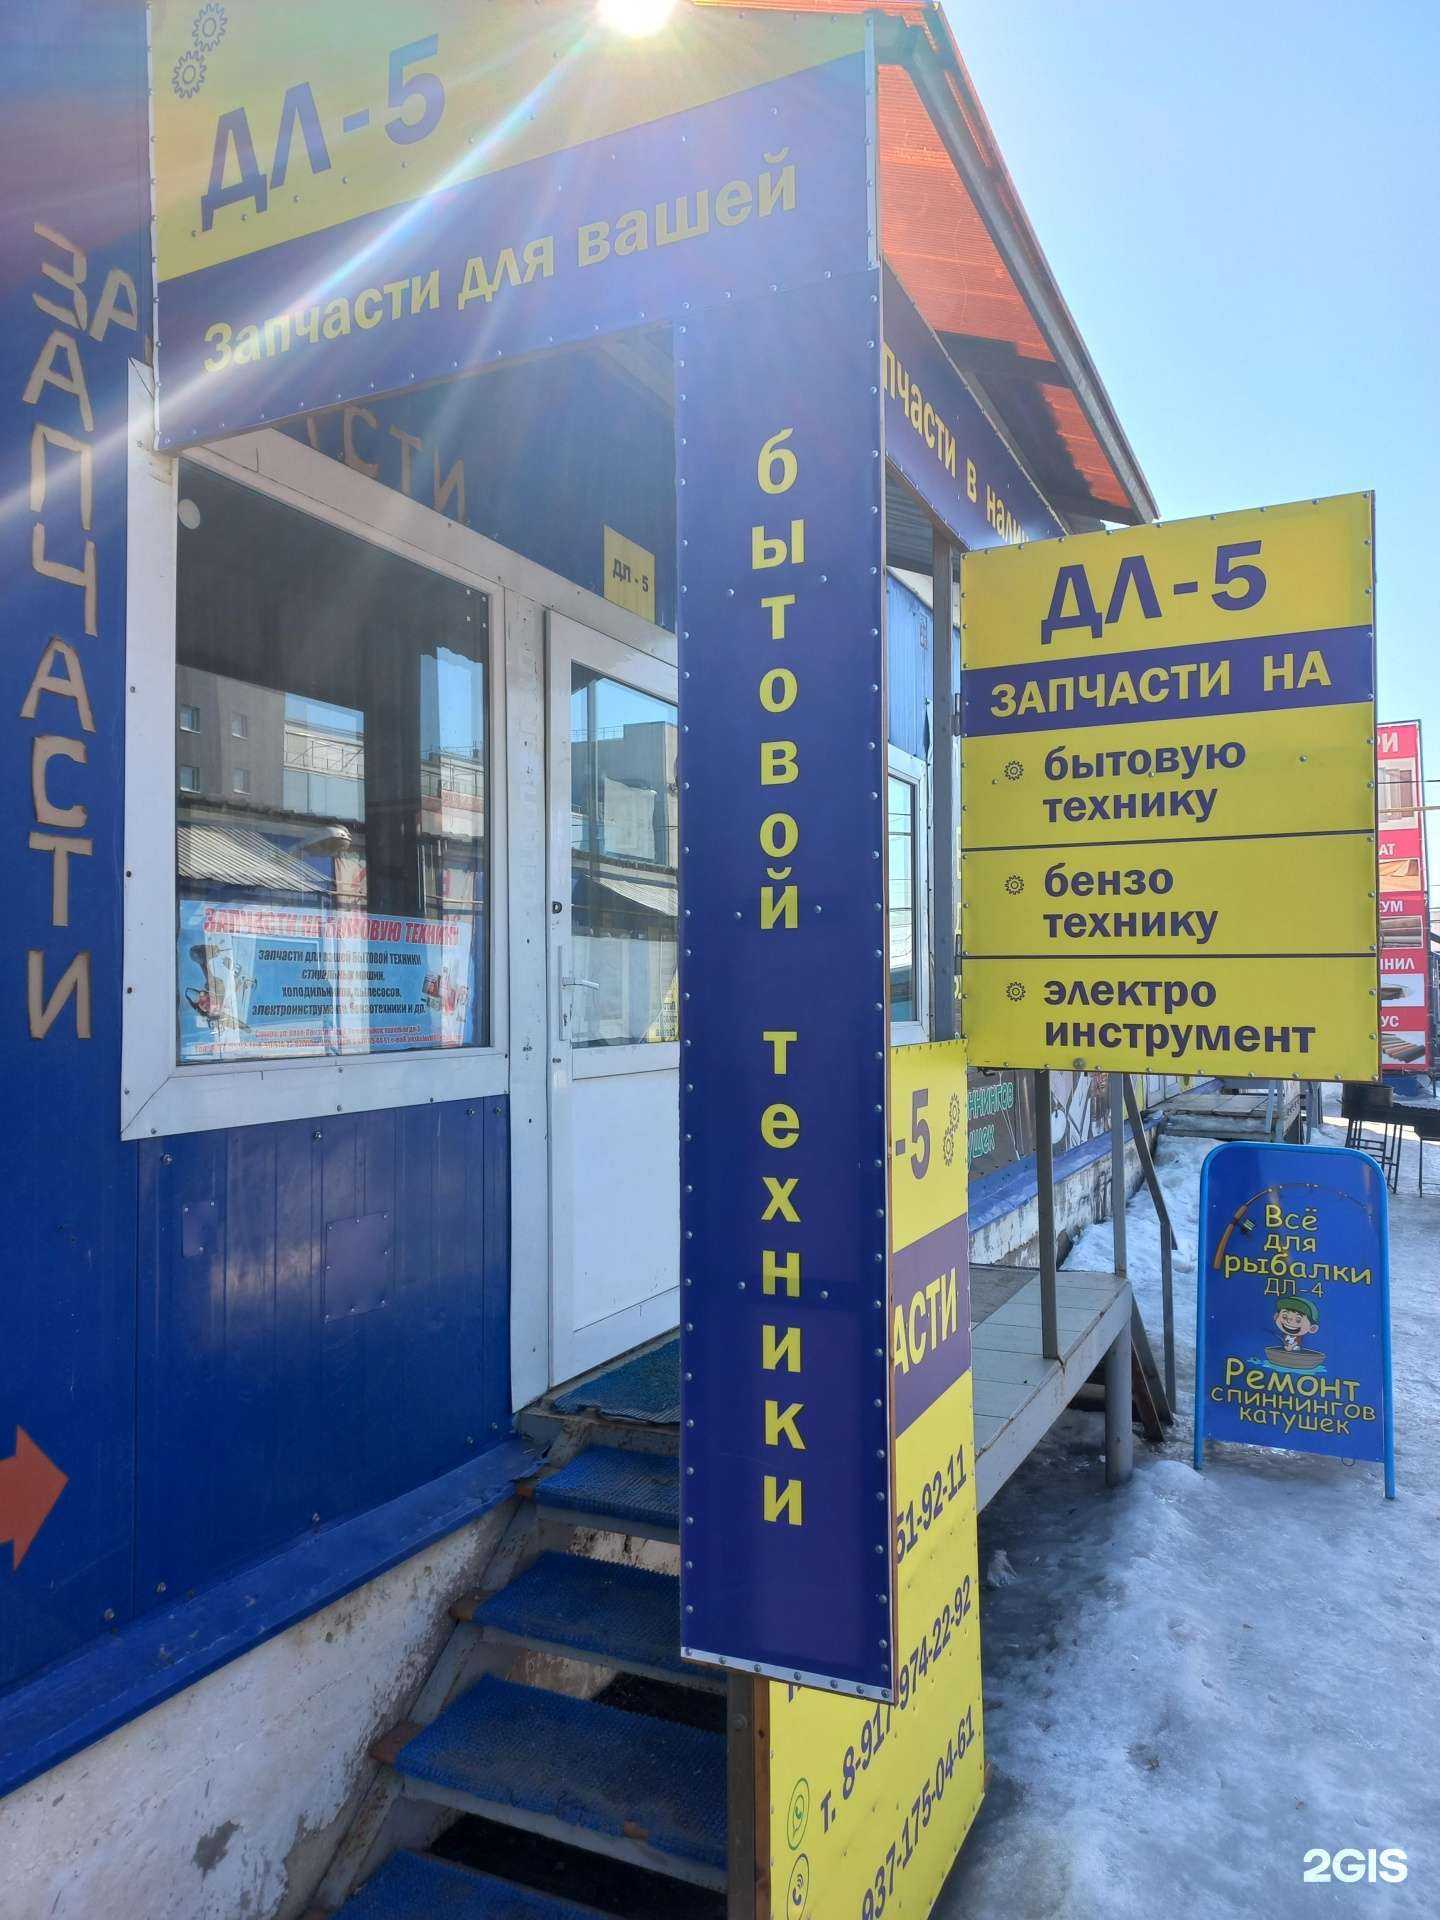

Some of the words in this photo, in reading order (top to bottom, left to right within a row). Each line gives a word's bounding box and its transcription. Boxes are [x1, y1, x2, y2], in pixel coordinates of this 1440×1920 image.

[200, 34, 447, 232] ДЛ-5
[203, 264, 440, 374] Запчасти
[457, 236, 555, 310] для
[577, 148, 797, 267] вашей
[1041, 540, 1267, 645] ДЛ-5
[752, 427, 805, 930] бытовой
[991, 660, 1230, 718] ЗАПЧАСТИ
[1263, 650, 1331, 692] НА
[1044, 741, 1246, 781] бытовую
[1042, 787, 1218, 824] технику
[1044, 862, 1174, 897] бензо
[1043, 908, 1219, 944] технику
[1043, 979, 1217, 1014] электро
[1045, 1021, 1317, 1057] инструмент
[1264, 1204, 1319, 1231] Всё
[1263, 1234, 1316, 1253] для
[760, 1031, 806, 1527] техники
[1224, 1250, 1372, 1285] рыбалки
[1226, 1358, 1360, 1402] Ремонт
[1211, 1386, 1377, 1421] спиннингов
[1240, 1406, 1350, 1435] катушек
